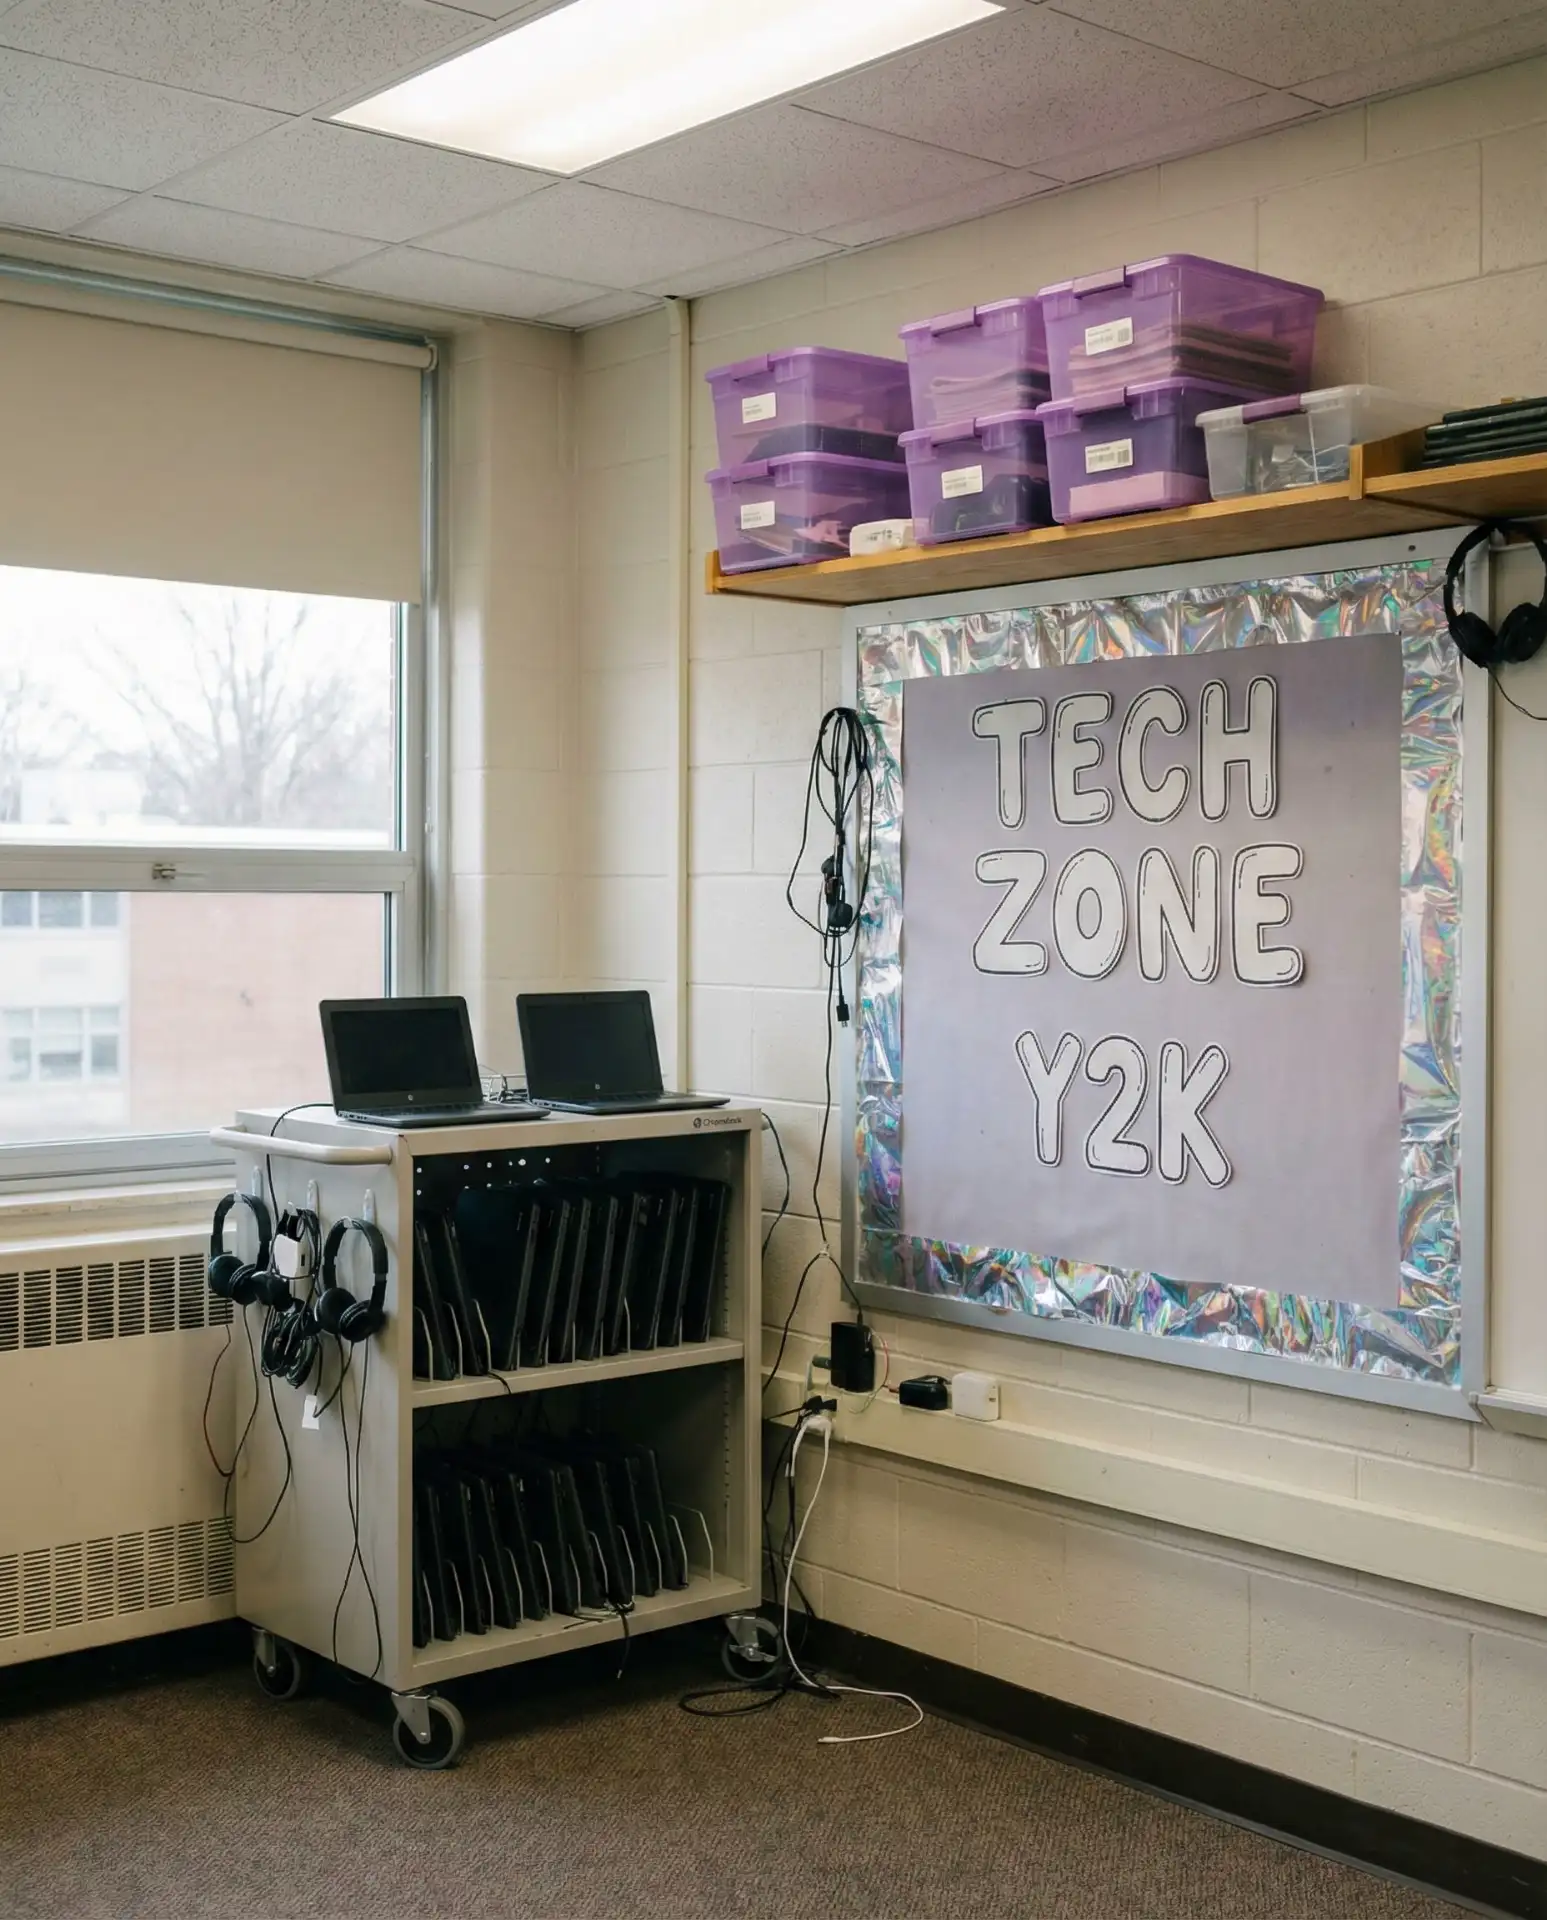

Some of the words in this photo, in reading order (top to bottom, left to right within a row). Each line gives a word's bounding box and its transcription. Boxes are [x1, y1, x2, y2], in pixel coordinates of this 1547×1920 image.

[972, 675, 1278, 829] TECH
[973, 843, 1304, 986] ZONE
[1014, 1030, 1232, 1189] Y2K
